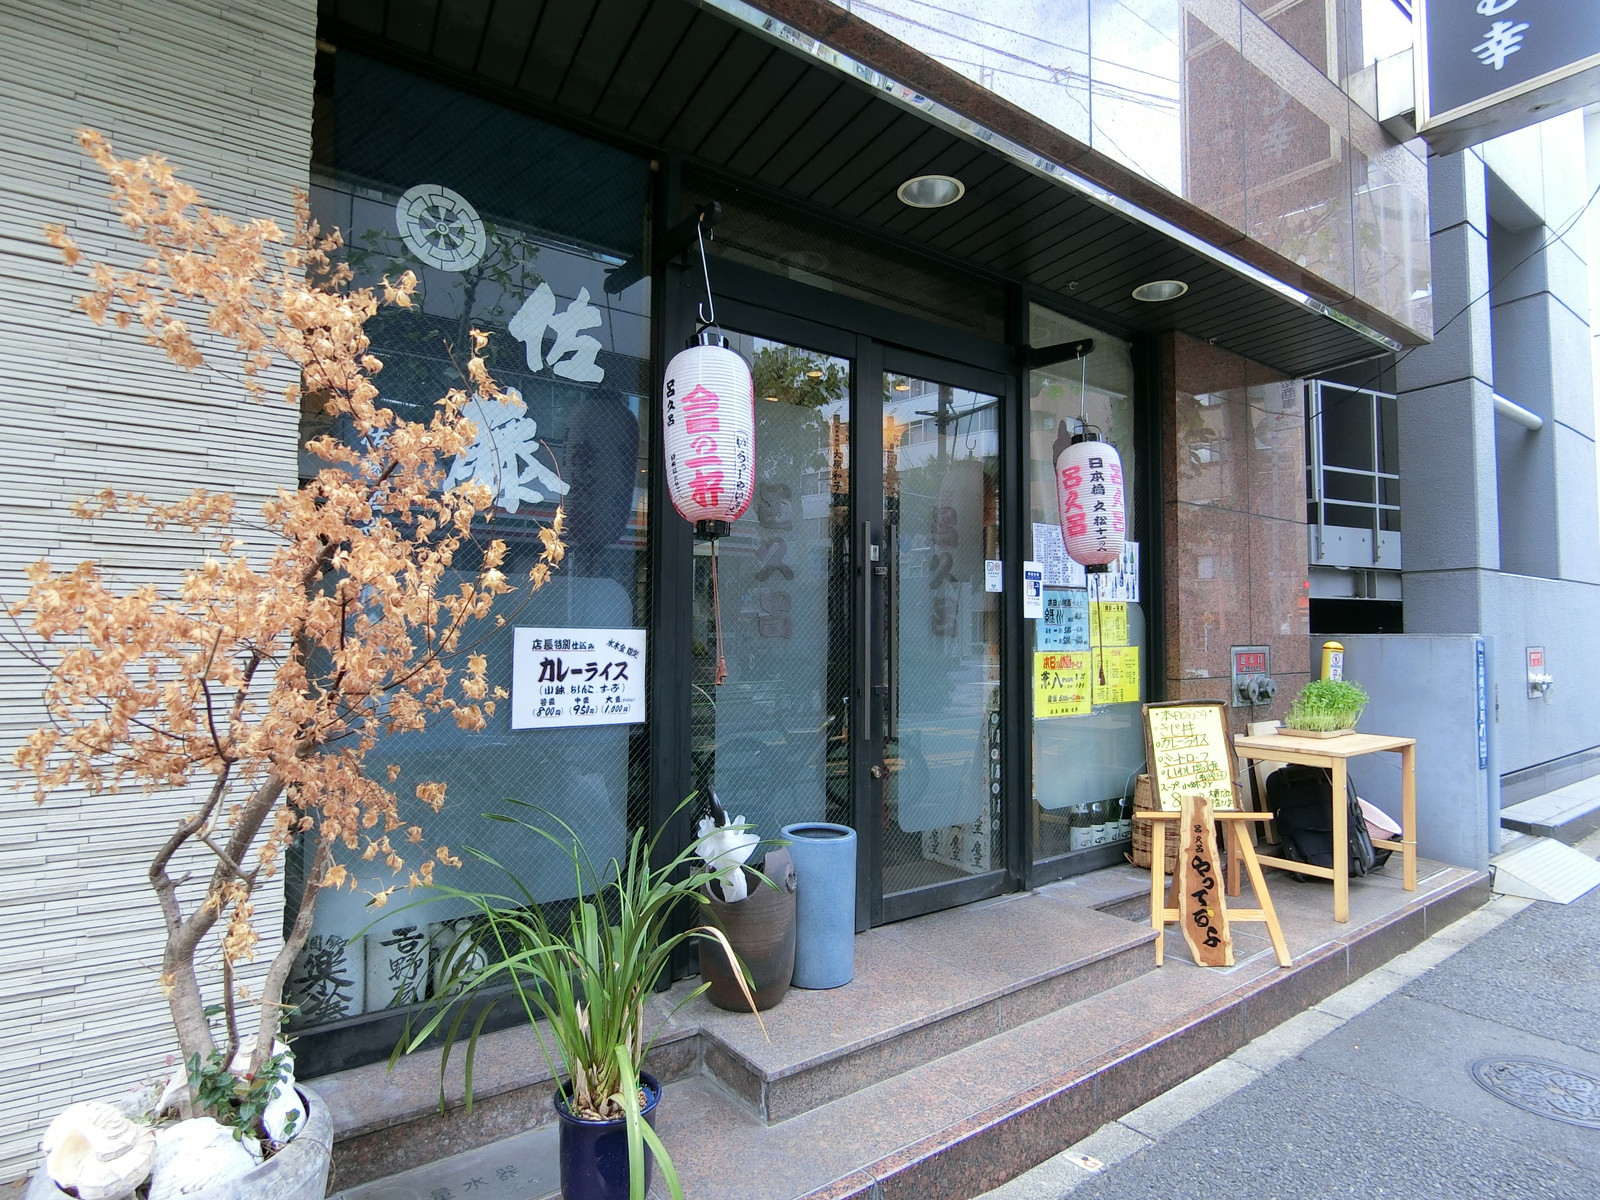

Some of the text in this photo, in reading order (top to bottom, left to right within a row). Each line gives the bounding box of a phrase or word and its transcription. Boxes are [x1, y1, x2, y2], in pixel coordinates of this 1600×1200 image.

[1471, 0, 1530, 71] 幸
[666, 378, 675, 427] 呂久呂
[1061, 465, 1088, 538] 呂久呂
[532, 638, 595, 650] 店長特別仕込み
[538, 657, 629, 682] カレーライス
